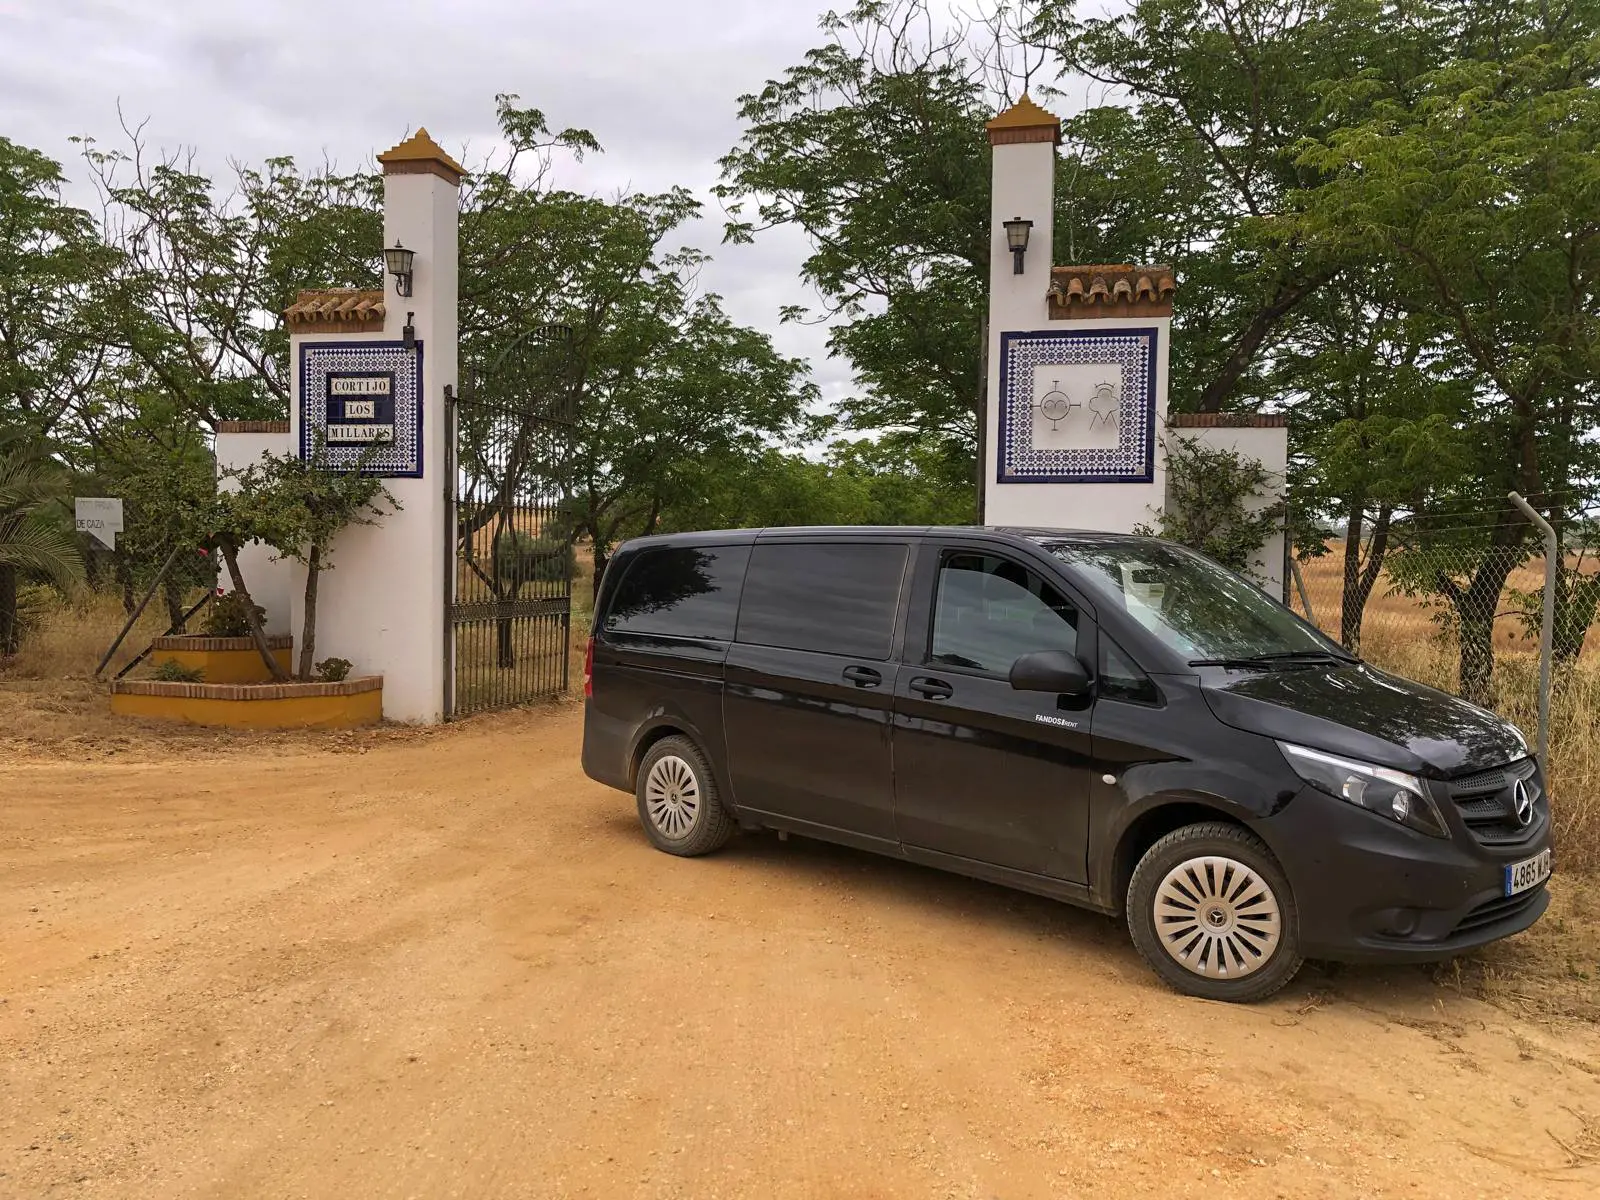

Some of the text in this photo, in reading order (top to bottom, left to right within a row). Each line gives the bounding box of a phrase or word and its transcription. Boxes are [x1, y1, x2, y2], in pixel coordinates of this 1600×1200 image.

[334, 381, 386, 391] CORTIJO
[349, 405, 370, 414] LOS
[331, 428, 390, 438] MILLARES
[77, 520, 86, 528] DE
[1514, 861, 1535, 888] 4865
